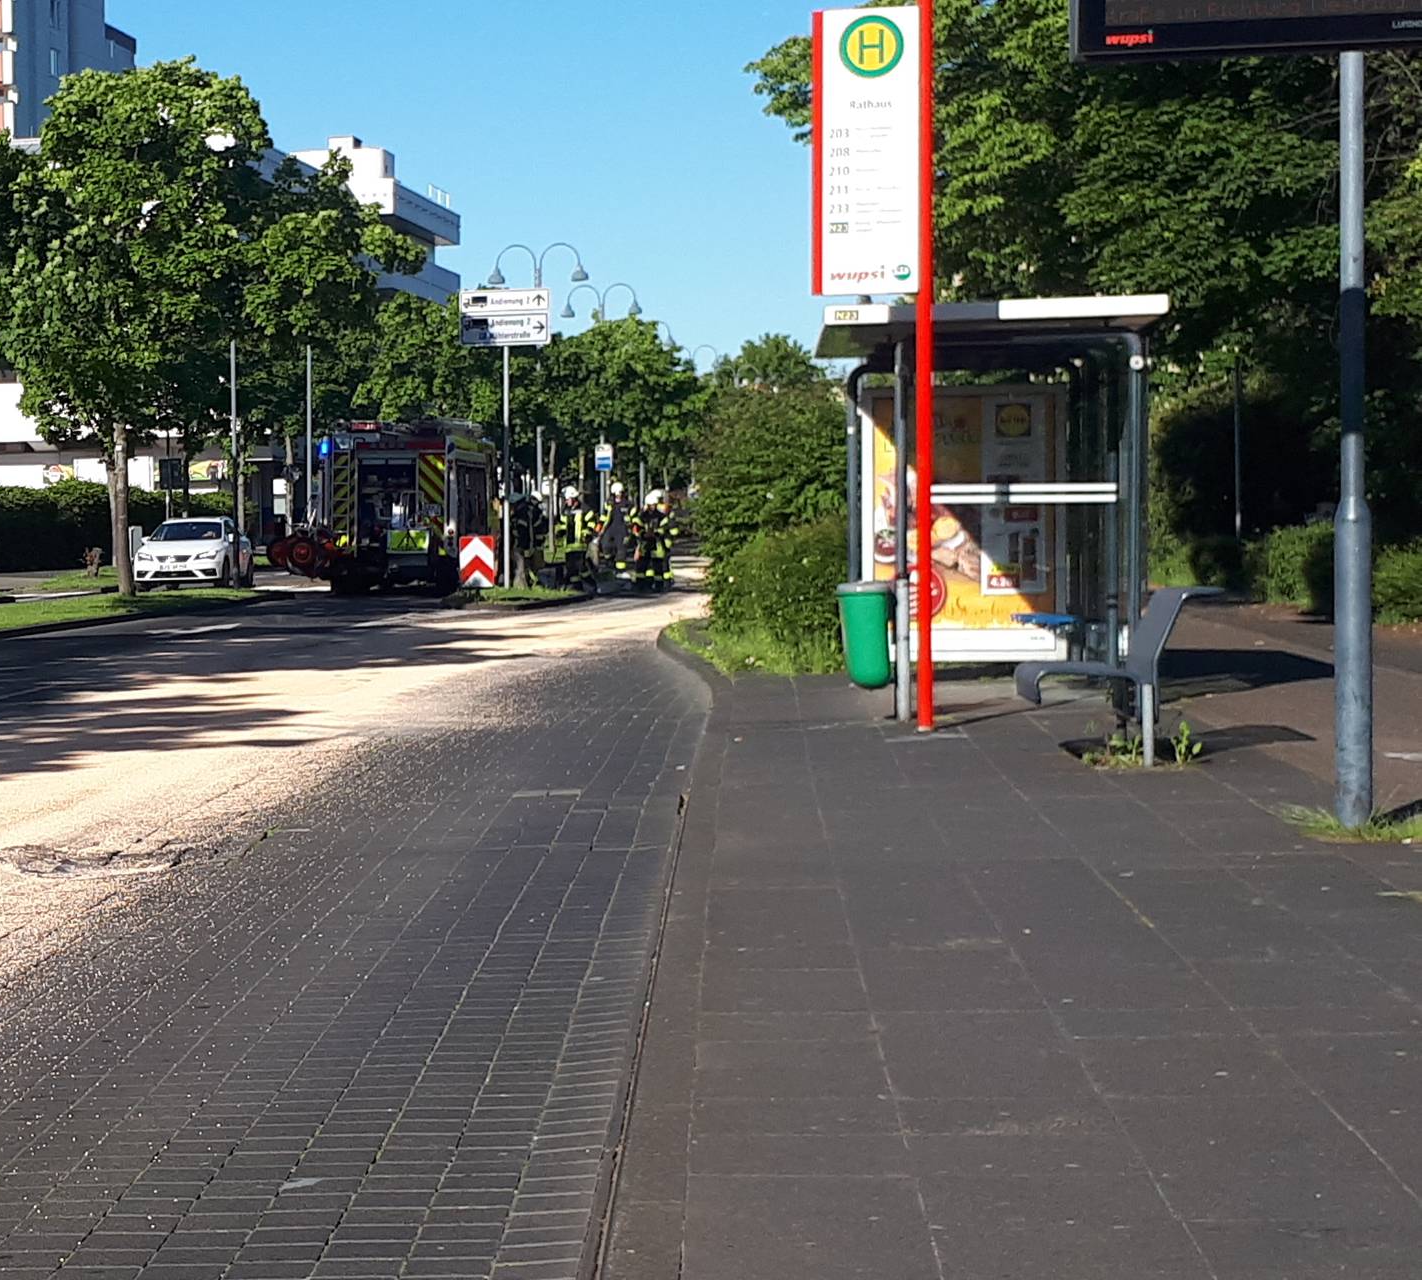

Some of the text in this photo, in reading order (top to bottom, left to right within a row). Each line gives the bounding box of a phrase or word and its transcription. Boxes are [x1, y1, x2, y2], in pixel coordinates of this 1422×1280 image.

[1105, 29, 1154, 47] wupsi
[849, 100, 893, 110] Rathaus
[829, 128, 850, 139] 203
[829, 147, 850, 158] 208
[829, 166, 850, 177] 210
[829, 185, 849, 196] 211
[830, 264, 885, 284] wupsi
